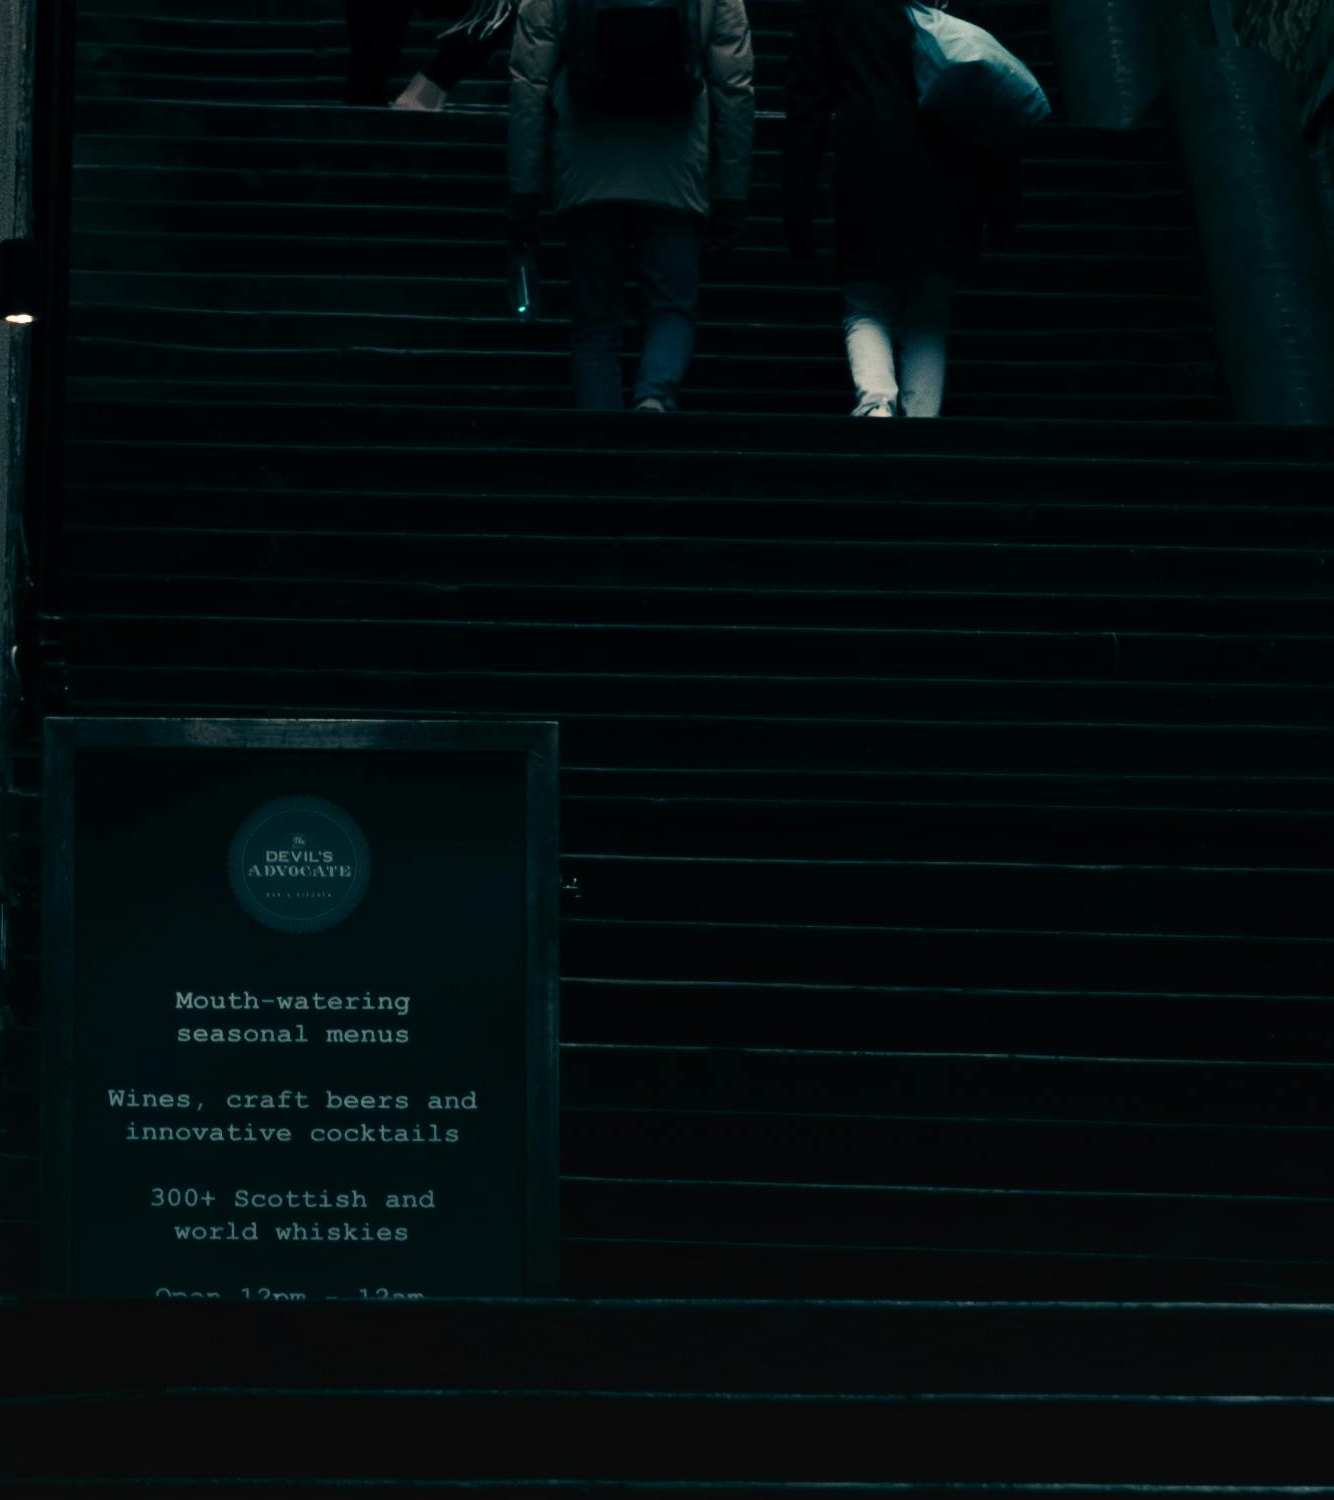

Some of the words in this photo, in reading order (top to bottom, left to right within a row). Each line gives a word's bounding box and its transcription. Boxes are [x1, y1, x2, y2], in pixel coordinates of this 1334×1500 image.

[265, 850, 334, 863] DEVIL'S
[247, 864, 353, 878] ADVOCATE
[175, 991, 411, 1016] Mouth-watering
[177, 1024, 308, 1043] seasonal
[326, 1029, 409, 1044] menus
[107, 1088, 205, 1112] Wines,
[226, 1090, 309, 1109] craft
[326, 1090, 409, 1110] beers
[428, 1091, 478, 1110] and
[127, 1122, 292, 1142] innovative
[310, 1123, 459, 1143] cocktails
[151, 1187, 215, 1207] 300+
[234, 1189, 367, 1208] Scottish
[385, 1189, 435, 1208] and
[174, 1221, 258, 1241] world
[275, 1222, 408, 1241] whiskies
